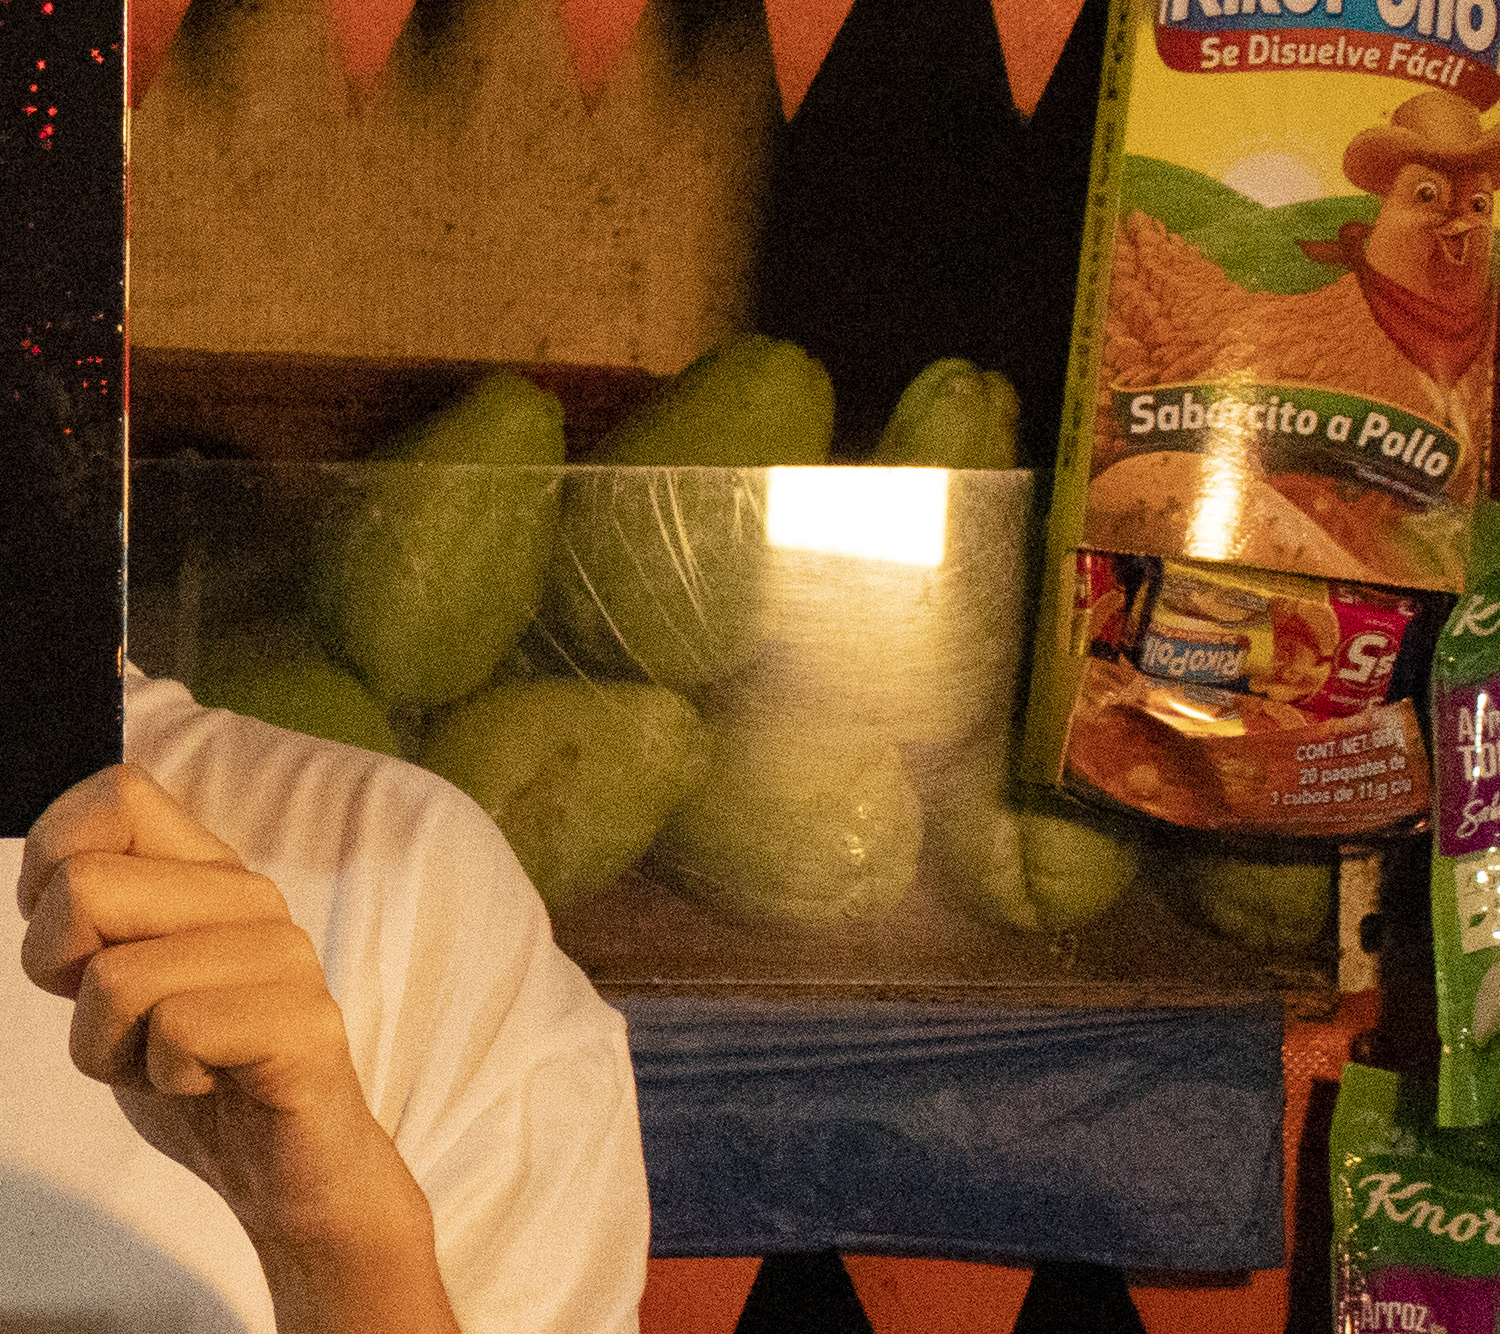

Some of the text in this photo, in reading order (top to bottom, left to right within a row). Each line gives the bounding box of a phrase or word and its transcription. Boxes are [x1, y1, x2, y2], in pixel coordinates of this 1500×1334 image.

[1200, 33, 1462, 87] Se Disuelve Fácil
[1326, 413, 1352, 442] a
[1358, 411, 1450, 477] Pollo
[1282, 789, 1331, 805] cubos
